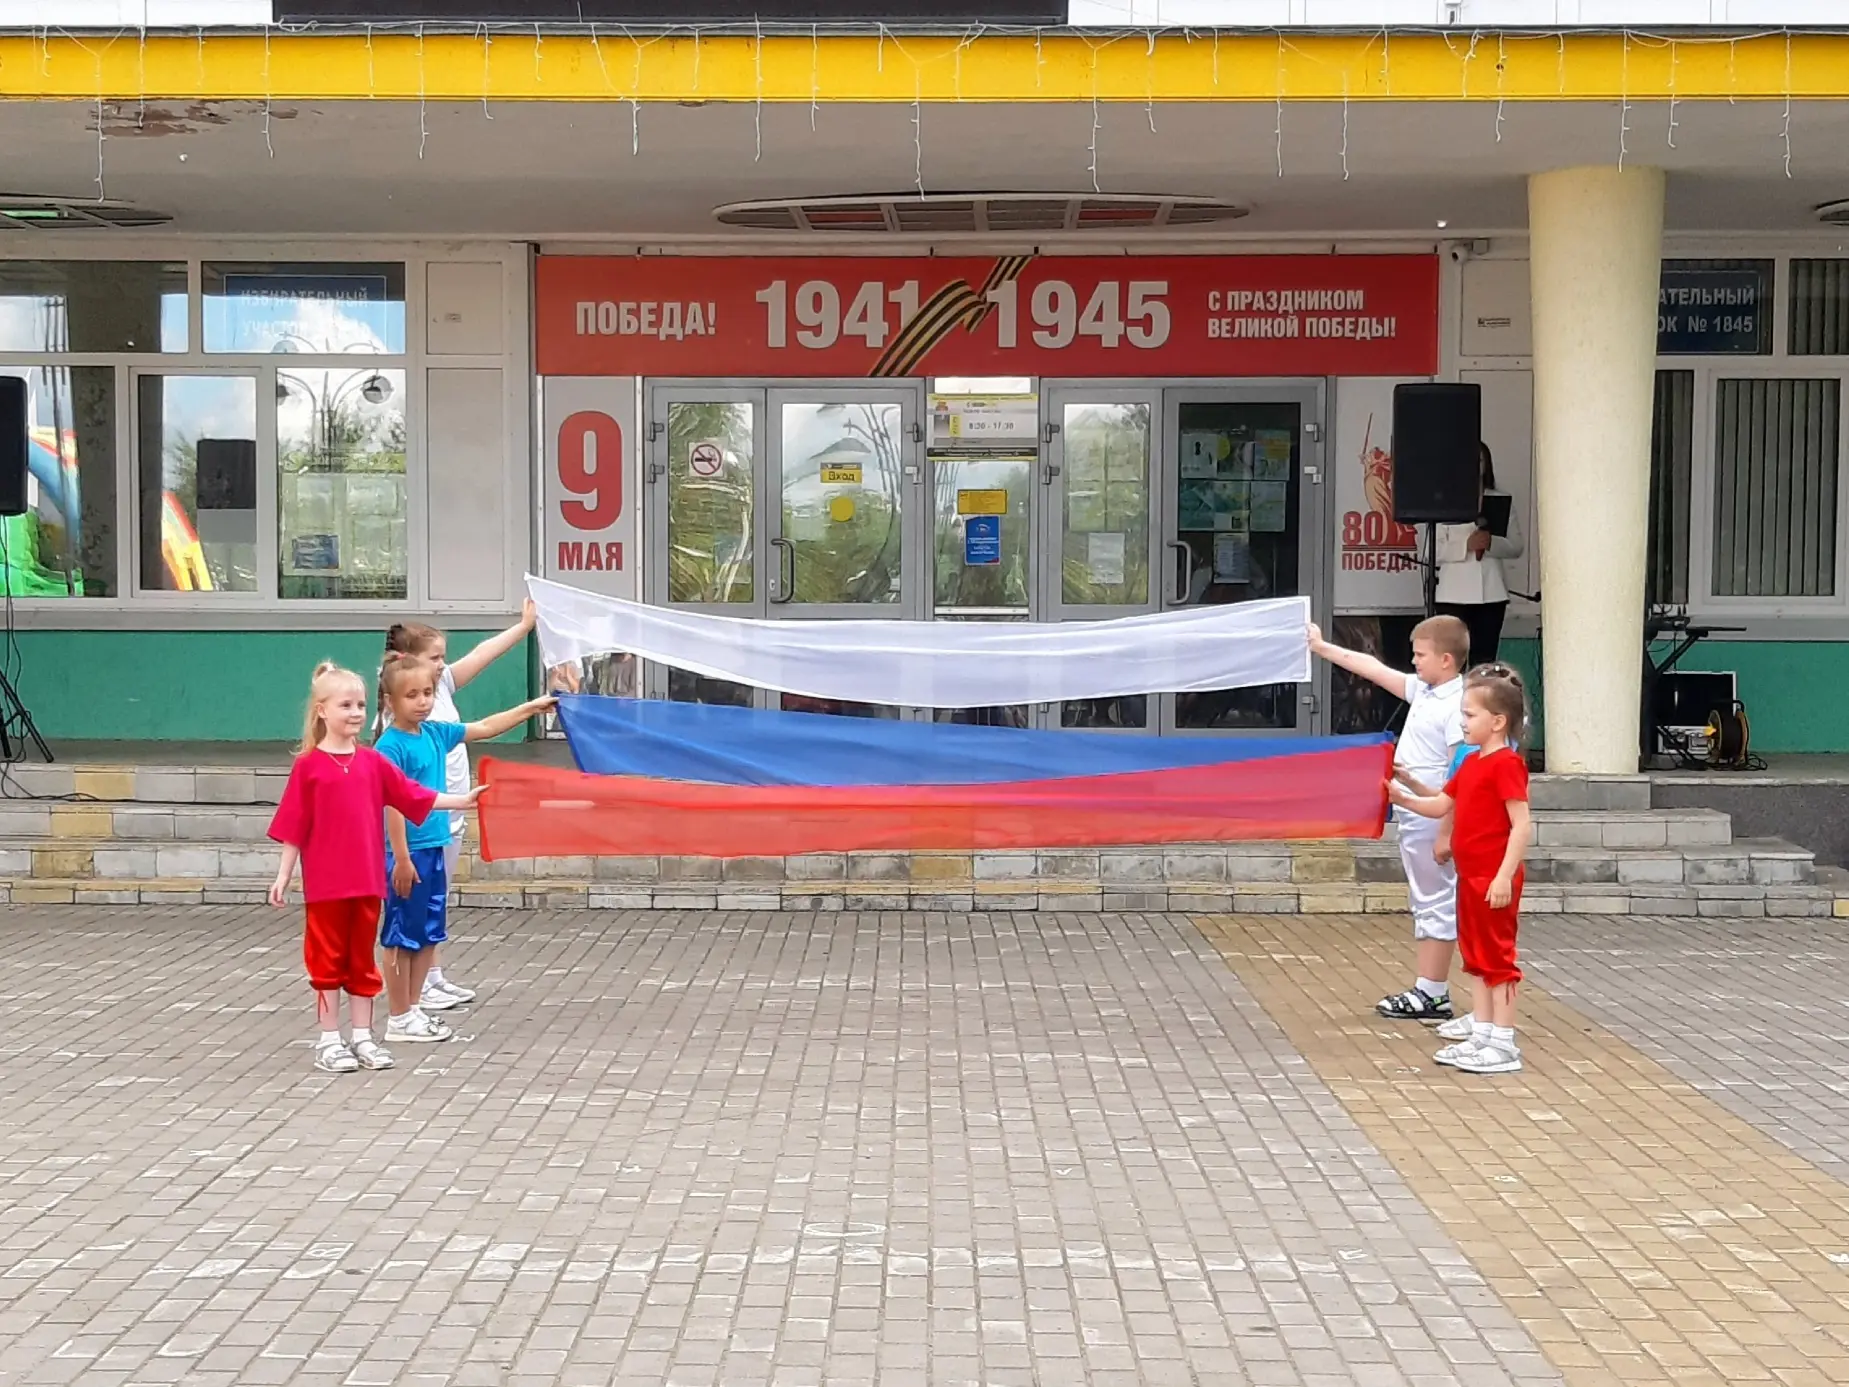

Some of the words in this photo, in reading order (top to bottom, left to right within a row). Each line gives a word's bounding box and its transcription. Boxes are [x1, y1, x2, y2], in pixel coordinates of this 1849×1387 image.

[986, 280, 1171, 349] 1945
[1208, 290, 1221, 312] С
[1226, 289, 1364, 314] ПРАЗДНИКОМ
[576, 301, 717, 341] ПОБЕДА!
[1207, 314, 1299, 338] ВЕЛИКОЙ
[1305, 317, 1397, 341] ПОБЕДЫ!
[1713, 315, 1753, 333] 1845
[557, 410, 622, 530] 9
[1342, 511, 1383, 545] 80
[558, 541, 623, 571] МАЯ
